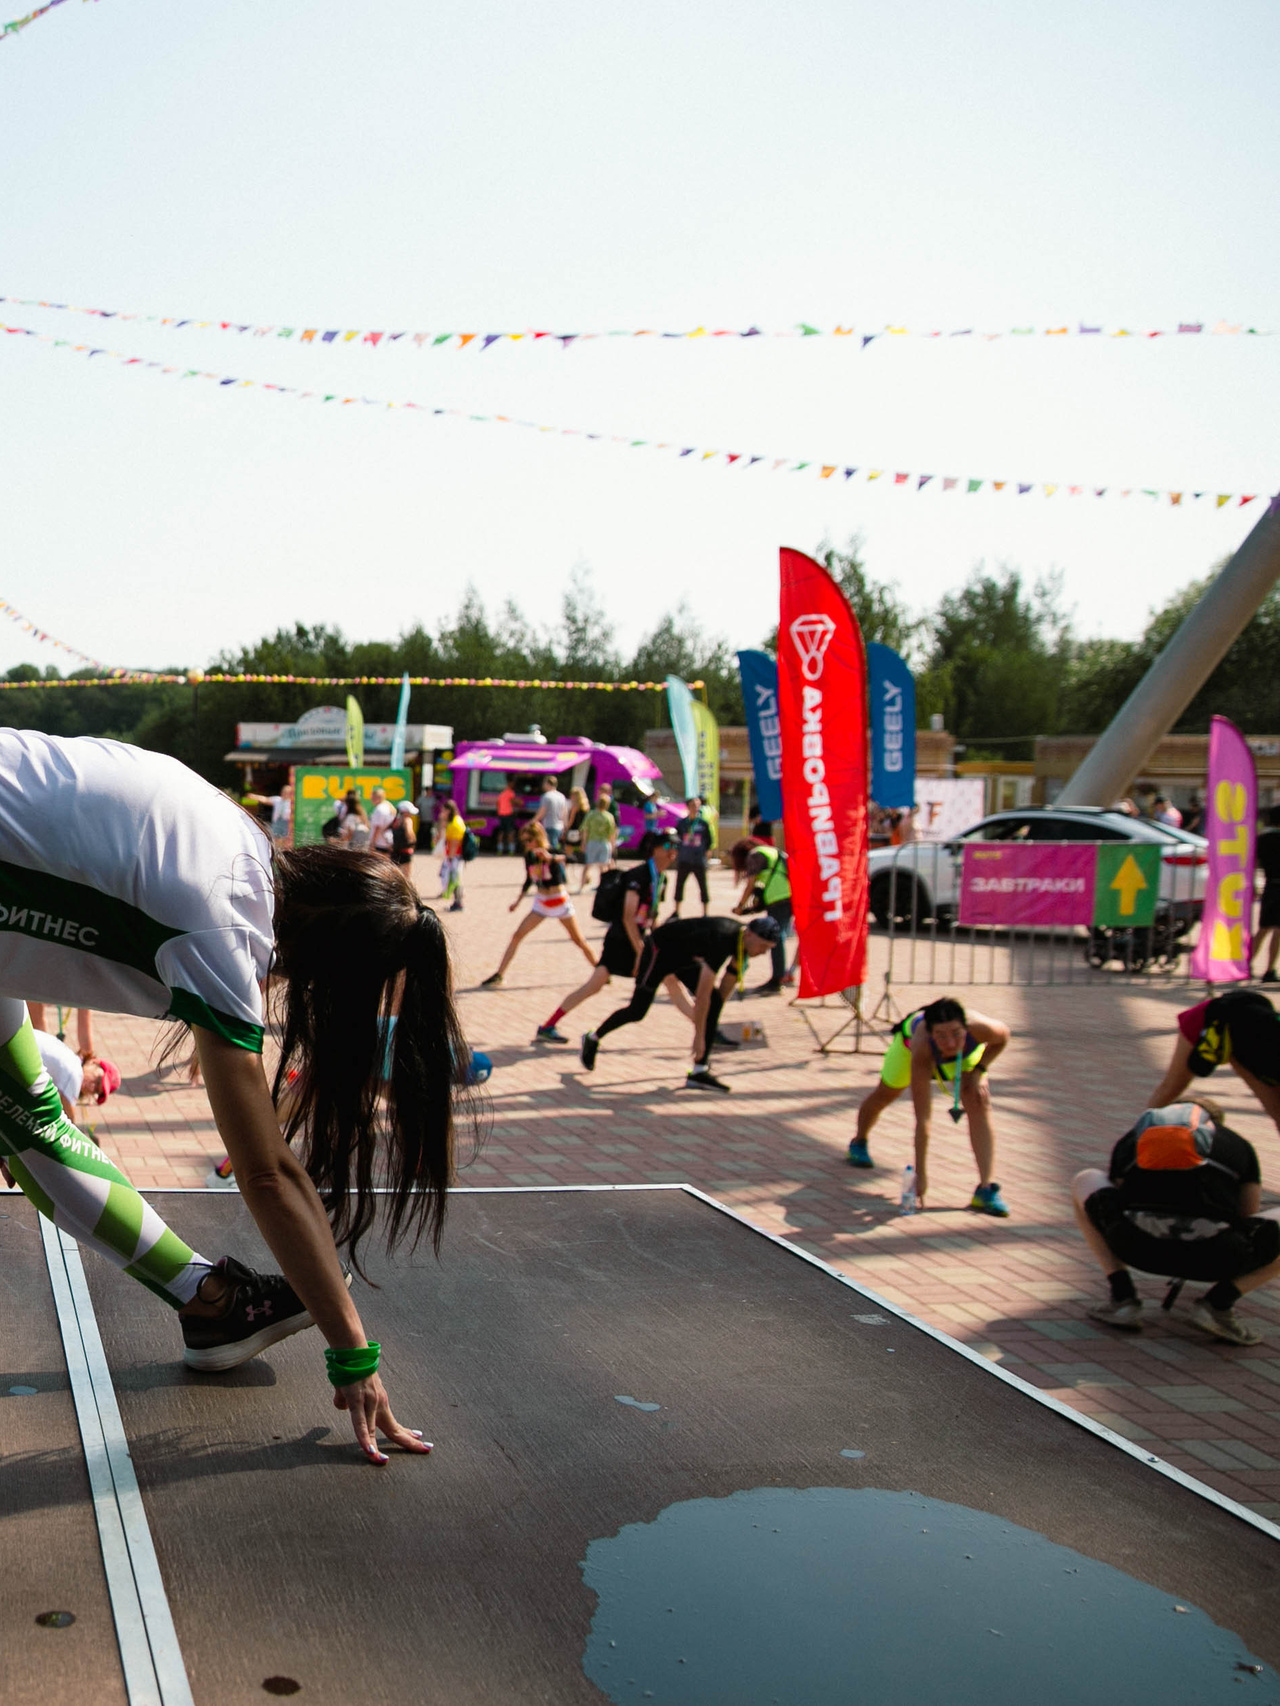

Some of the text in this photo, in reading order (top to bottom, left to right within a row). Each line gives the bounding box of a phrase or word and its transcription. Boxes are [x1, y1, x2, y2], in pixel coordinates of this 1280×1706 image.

[755, 684, 782, 781] GEELY
[883, 680, 903, 773] GEELY
[302, 775, 406, 800] RUTS
[970, 877, 1085, 894] ЗАВТРАКИ
